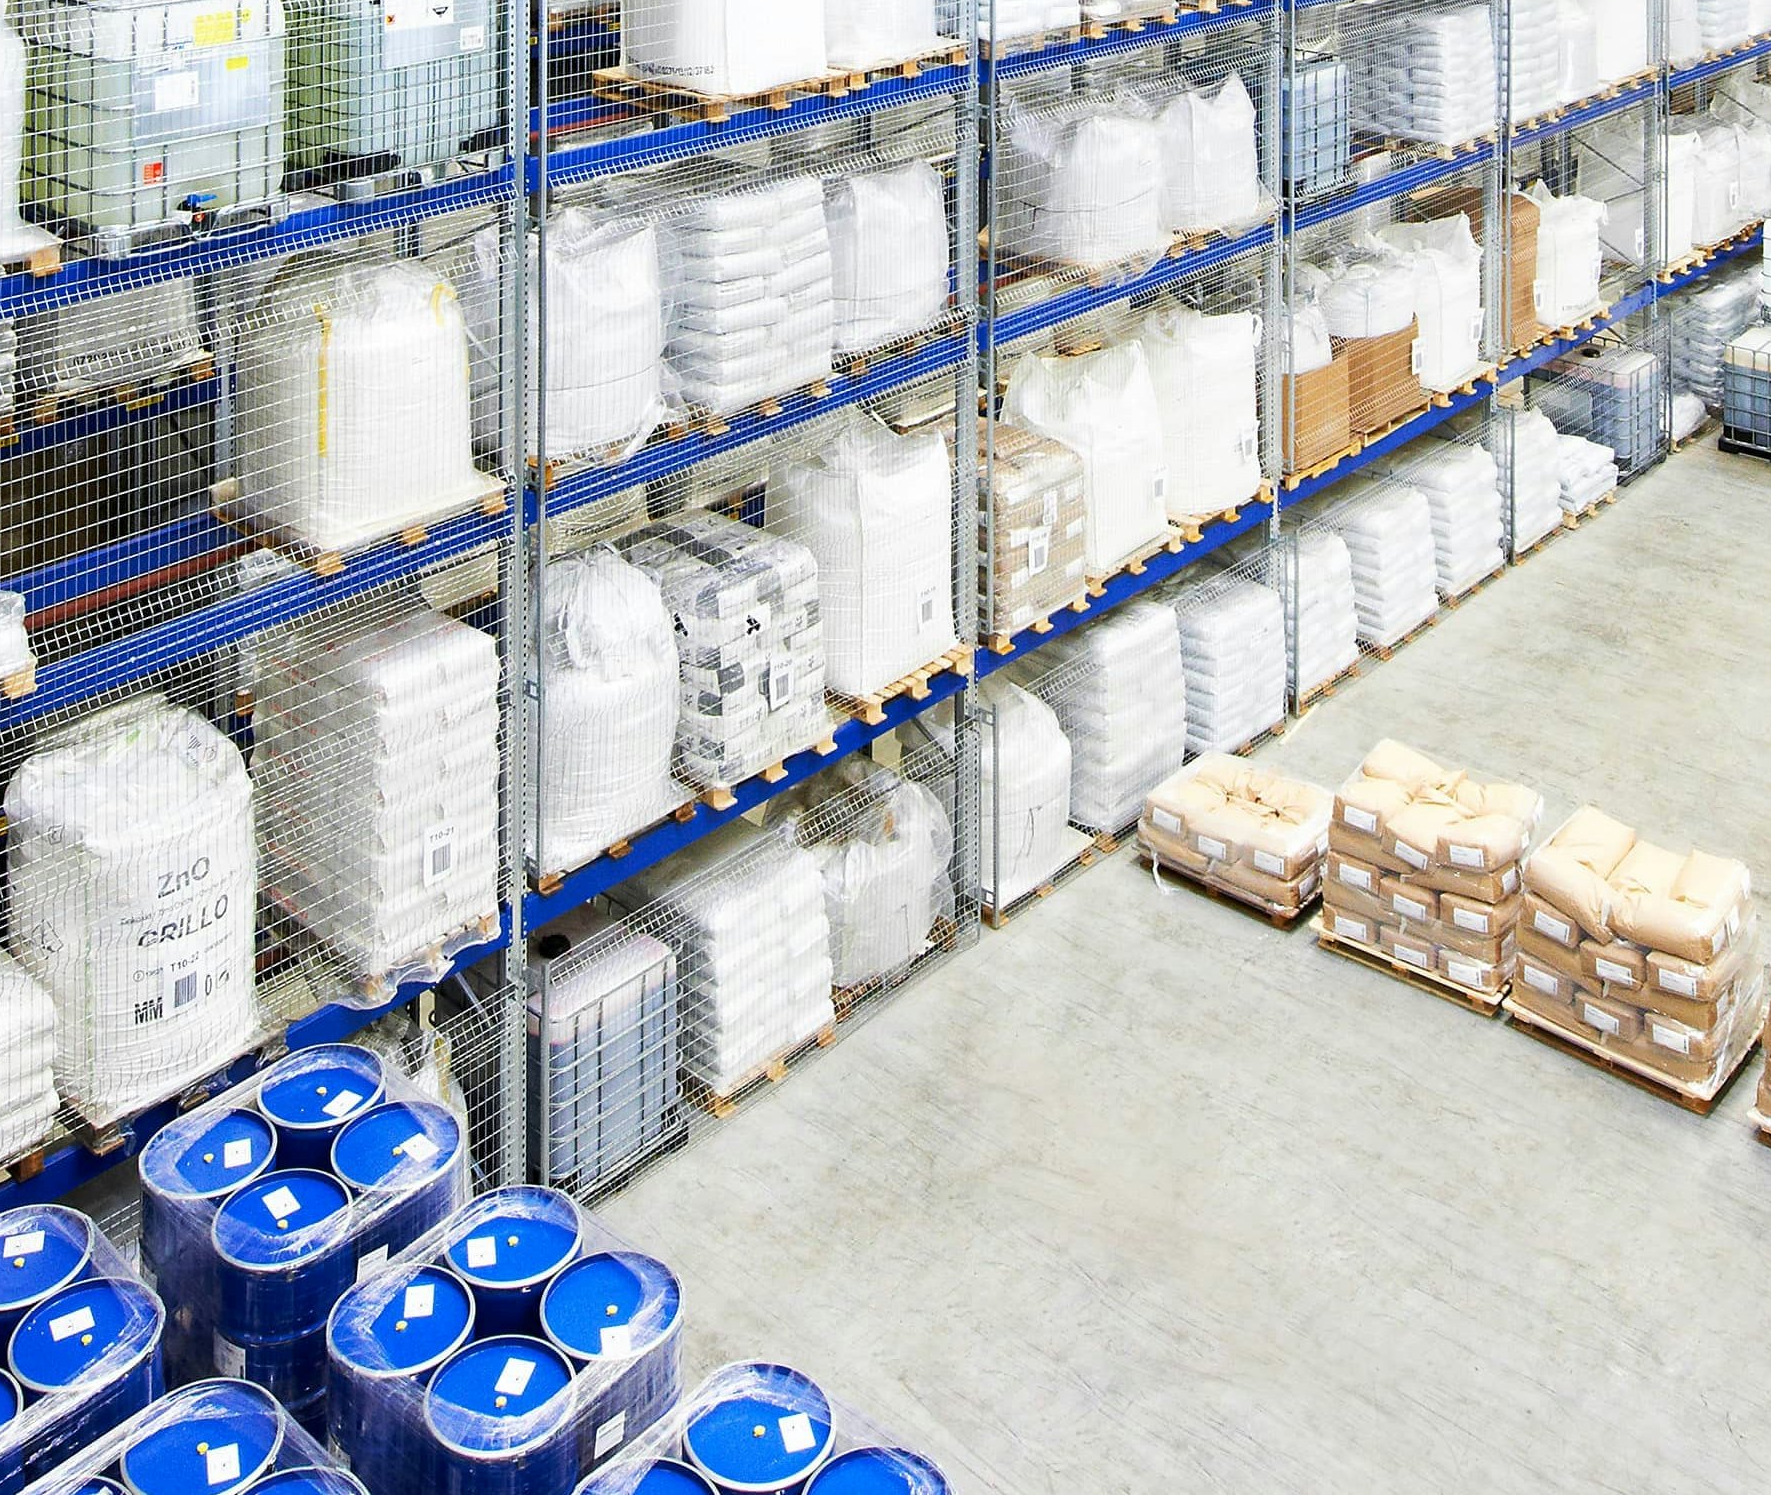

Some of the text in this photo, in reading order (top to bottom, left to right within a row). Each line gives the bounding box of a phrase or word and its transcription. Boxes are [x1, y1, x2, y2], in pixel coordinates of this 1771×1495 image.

[157, 856, 211, 899] ZnO
[137, 894, 229, 947] GRILLO
[134, 996, 163, 1025] MM
